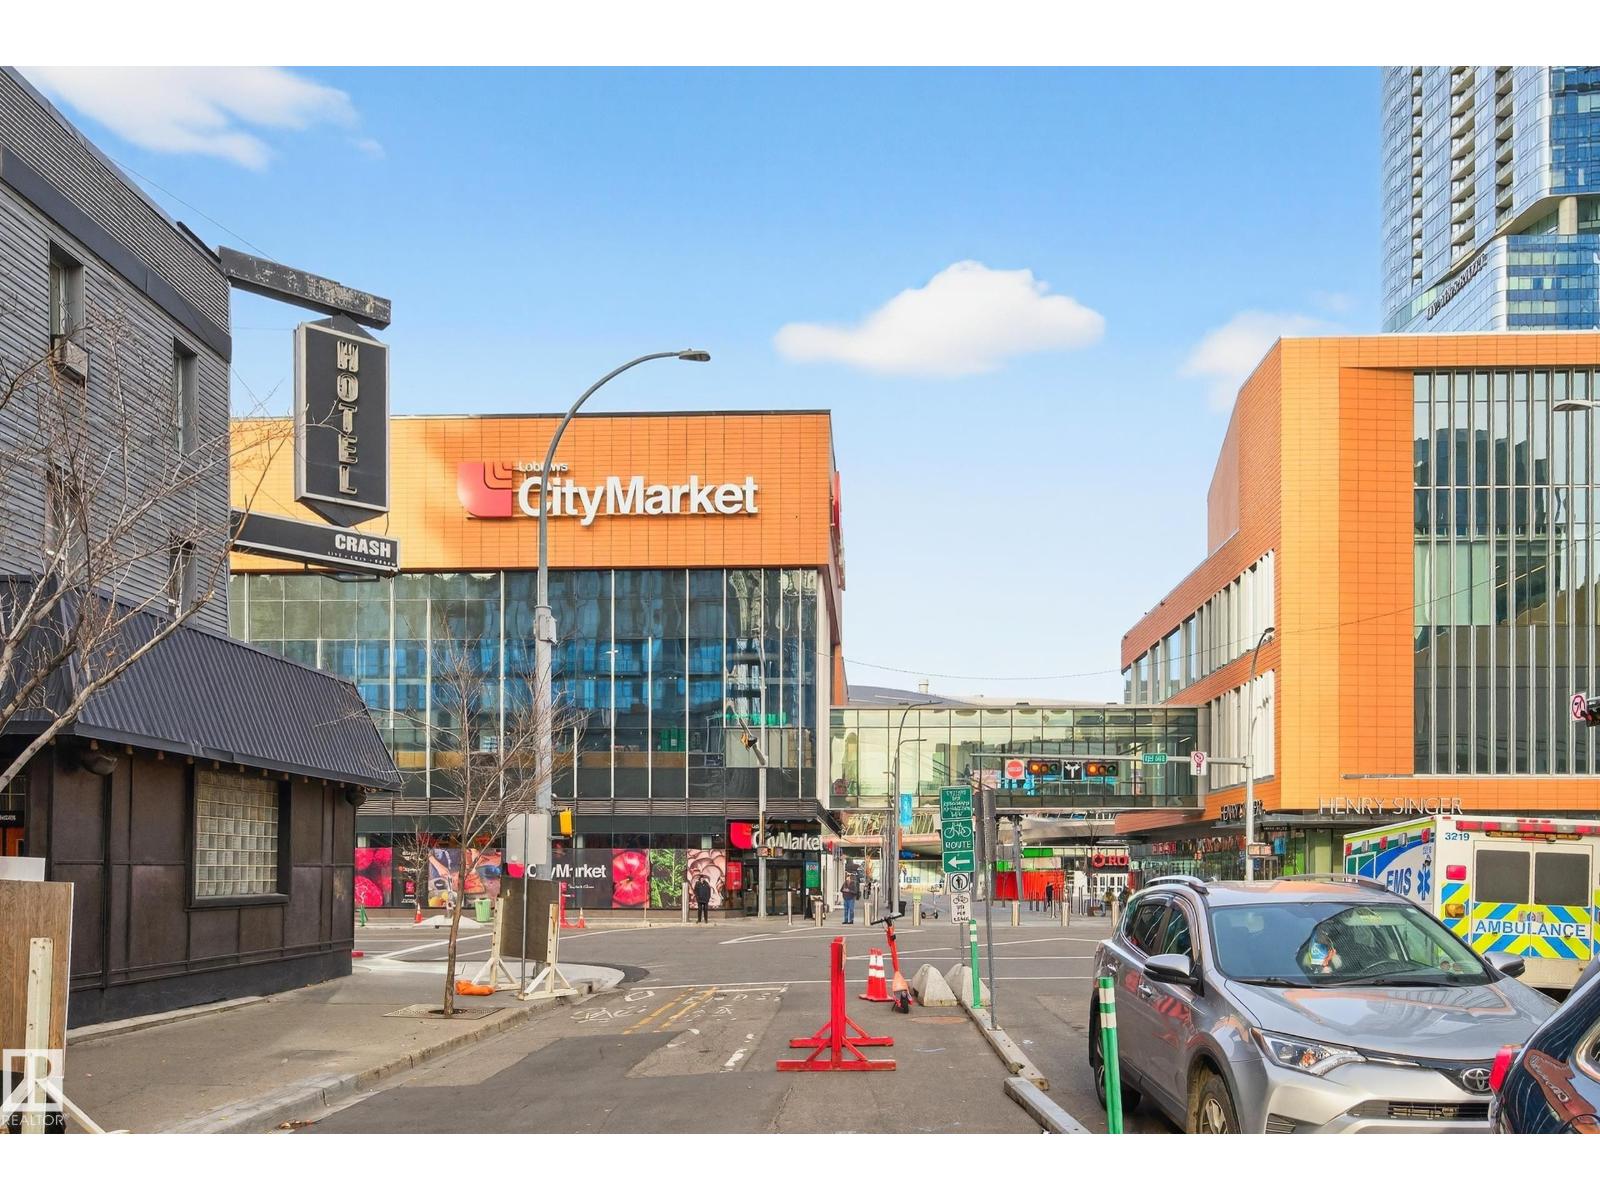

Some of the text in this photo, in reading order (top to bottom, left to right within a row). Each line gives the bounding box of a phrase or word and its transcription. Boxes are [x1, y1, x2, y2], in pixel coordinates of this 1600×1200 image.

[337, 341, 359, 494] HOTEL
[518, 475, 758, 526] CityMarket
[335, 534, 391, 558] CRASH
[1319, 798, 1463, 815] HENRY SINGER
[945, 841, 971, 849] ROUTE
[1445, 832, 1470, 841] 3219
[1387, 867, 1412, 896] EMS
[1475, 921, 1586, 937] AMBULANCE
